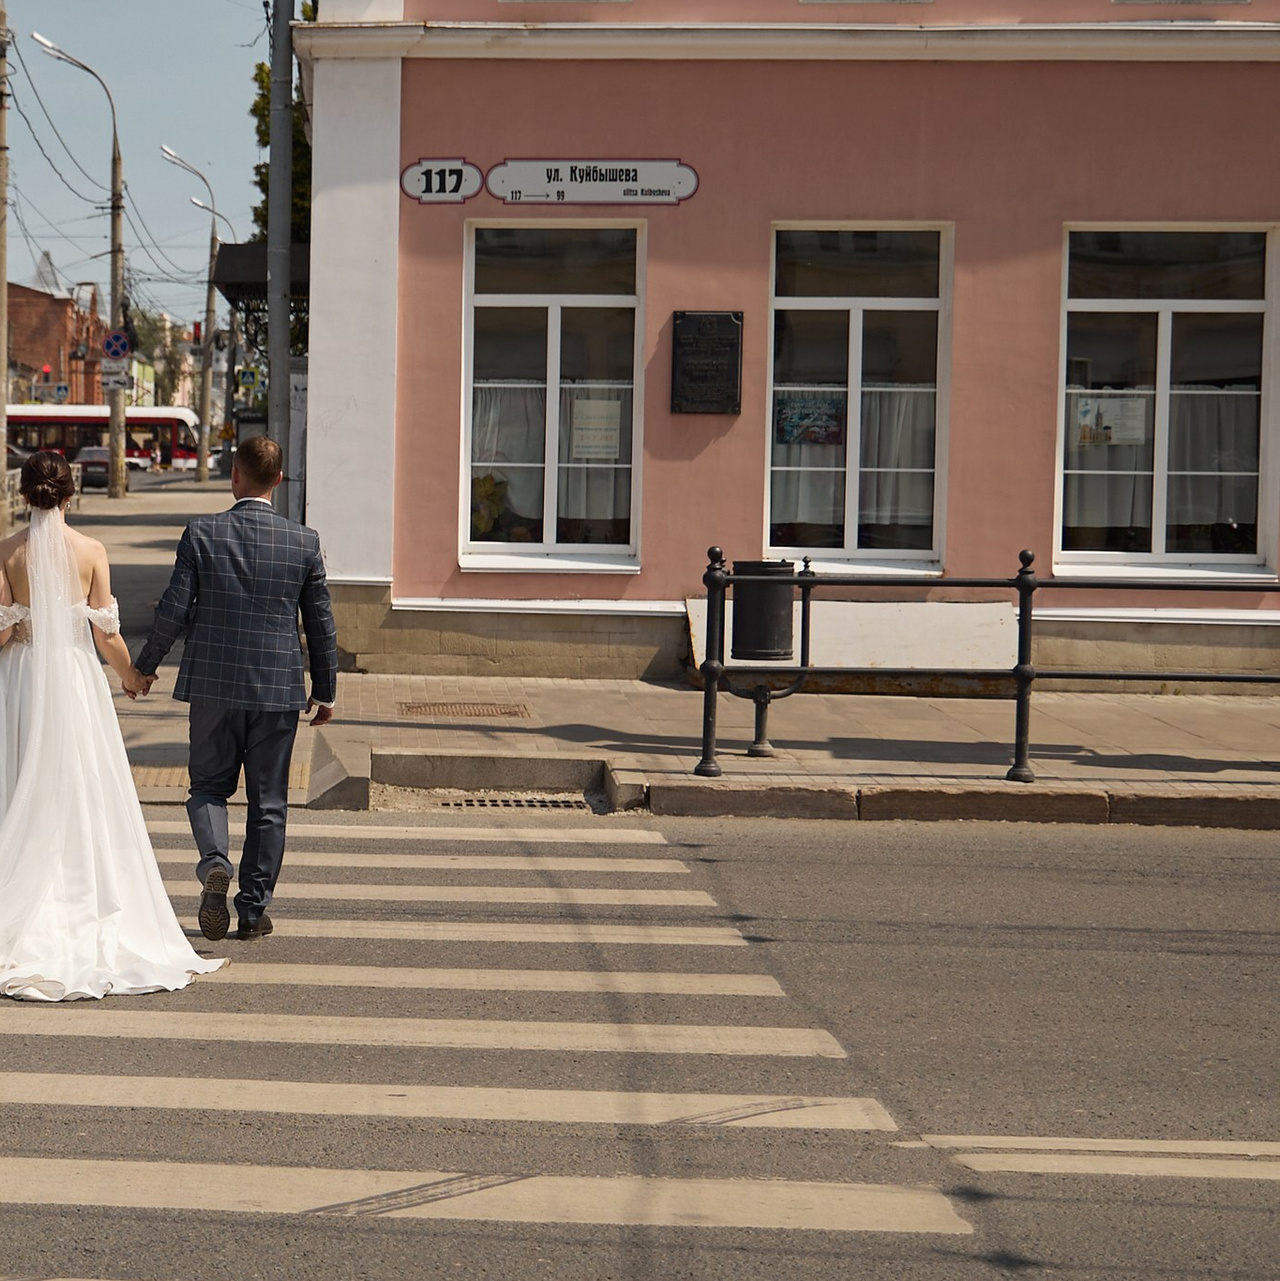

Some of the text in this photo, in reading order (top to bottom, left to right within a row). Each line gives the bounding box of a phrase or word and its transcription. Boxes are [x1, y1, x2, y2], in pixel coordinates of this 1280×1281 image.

[421, 169, 463, 194] 117
[546, 165, 638, 184] ул. Куйбышева
[511, 190, 565, 200] 117 99
